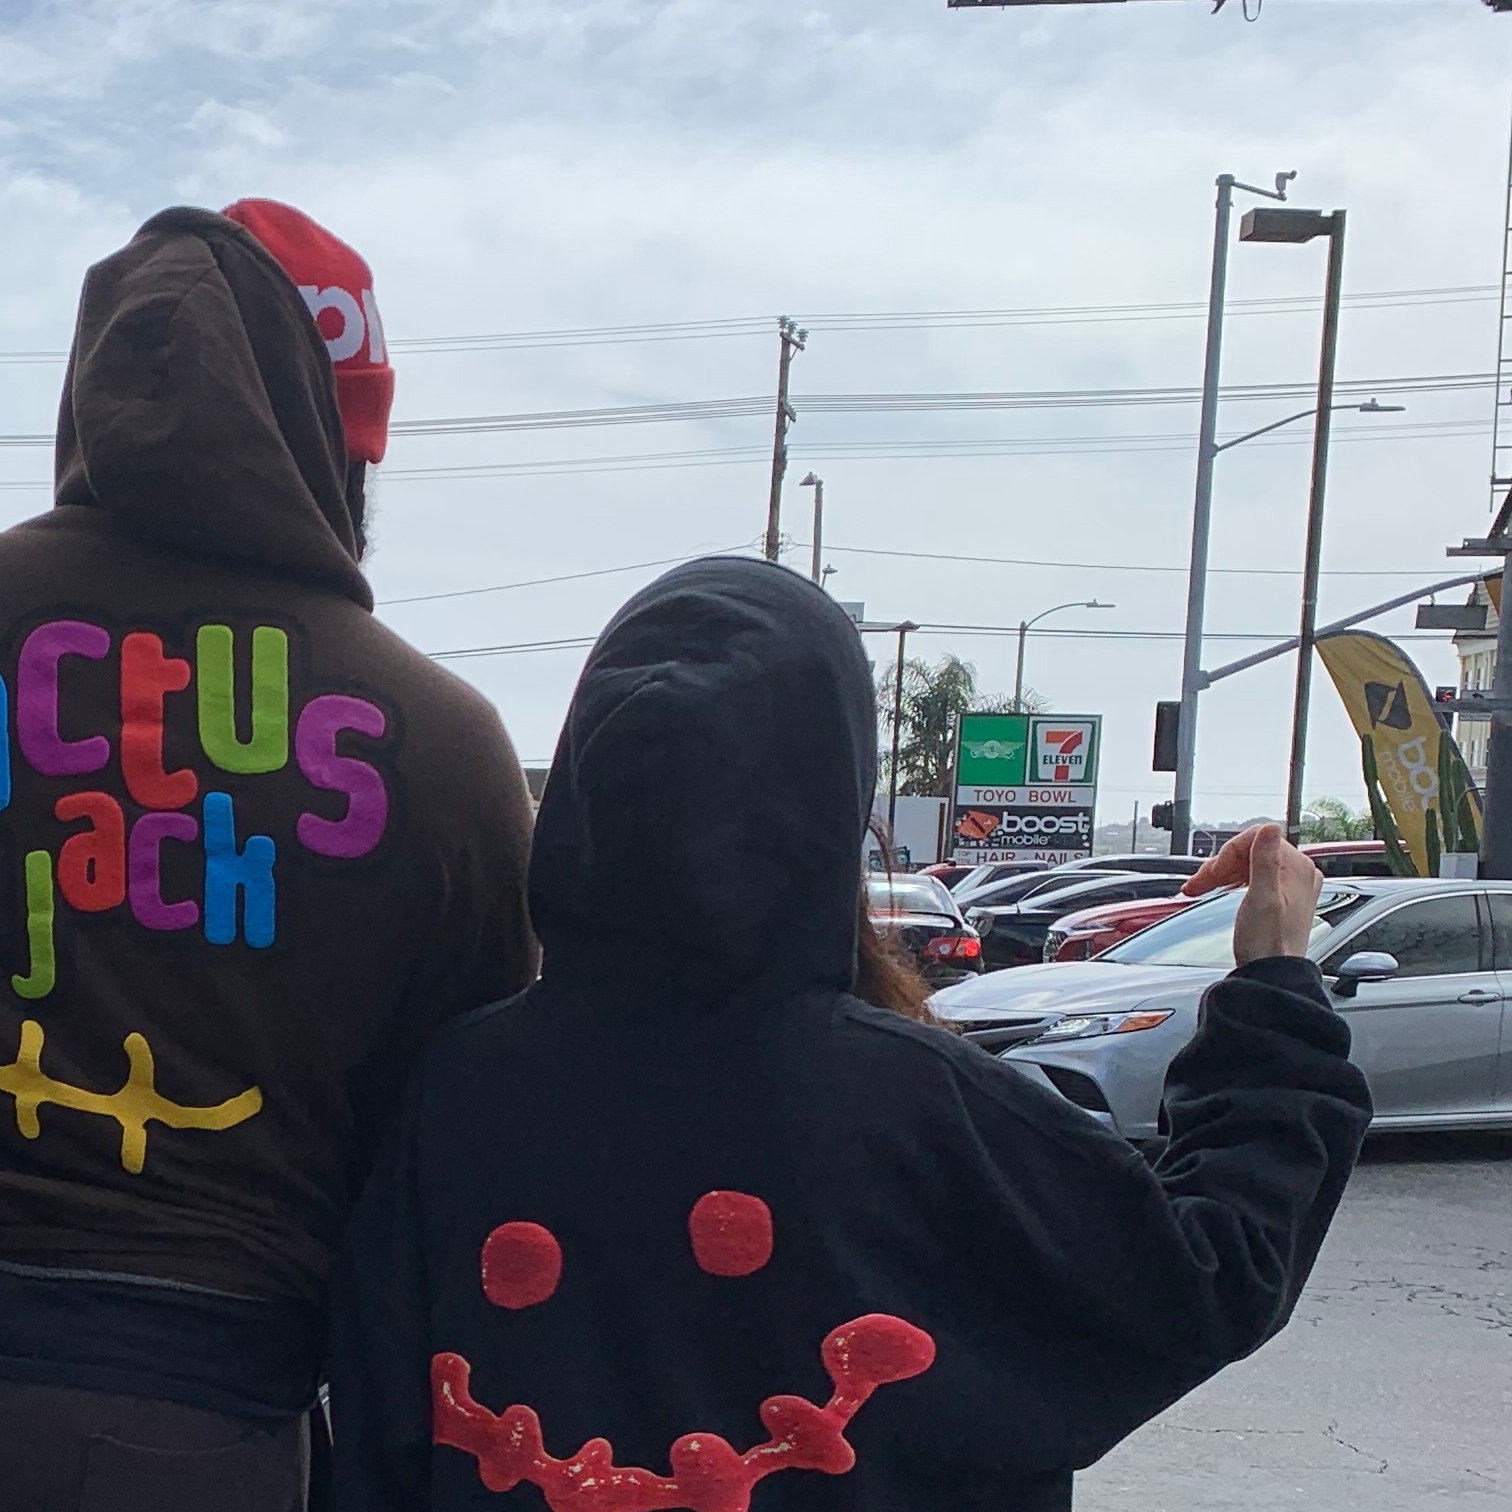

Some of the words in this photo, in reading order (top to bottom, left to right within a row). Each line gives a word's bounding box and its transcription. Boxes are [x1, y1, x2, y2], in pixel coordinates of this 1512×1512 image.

[1045, 731, 1083, 782] 7
[974, 789, 1017, 803] TOYO
[1029, 790, 1077, 803] BOWL
[1002, 811, 1090, 834] boost
[1000, 834, 1050, 846] mobile
